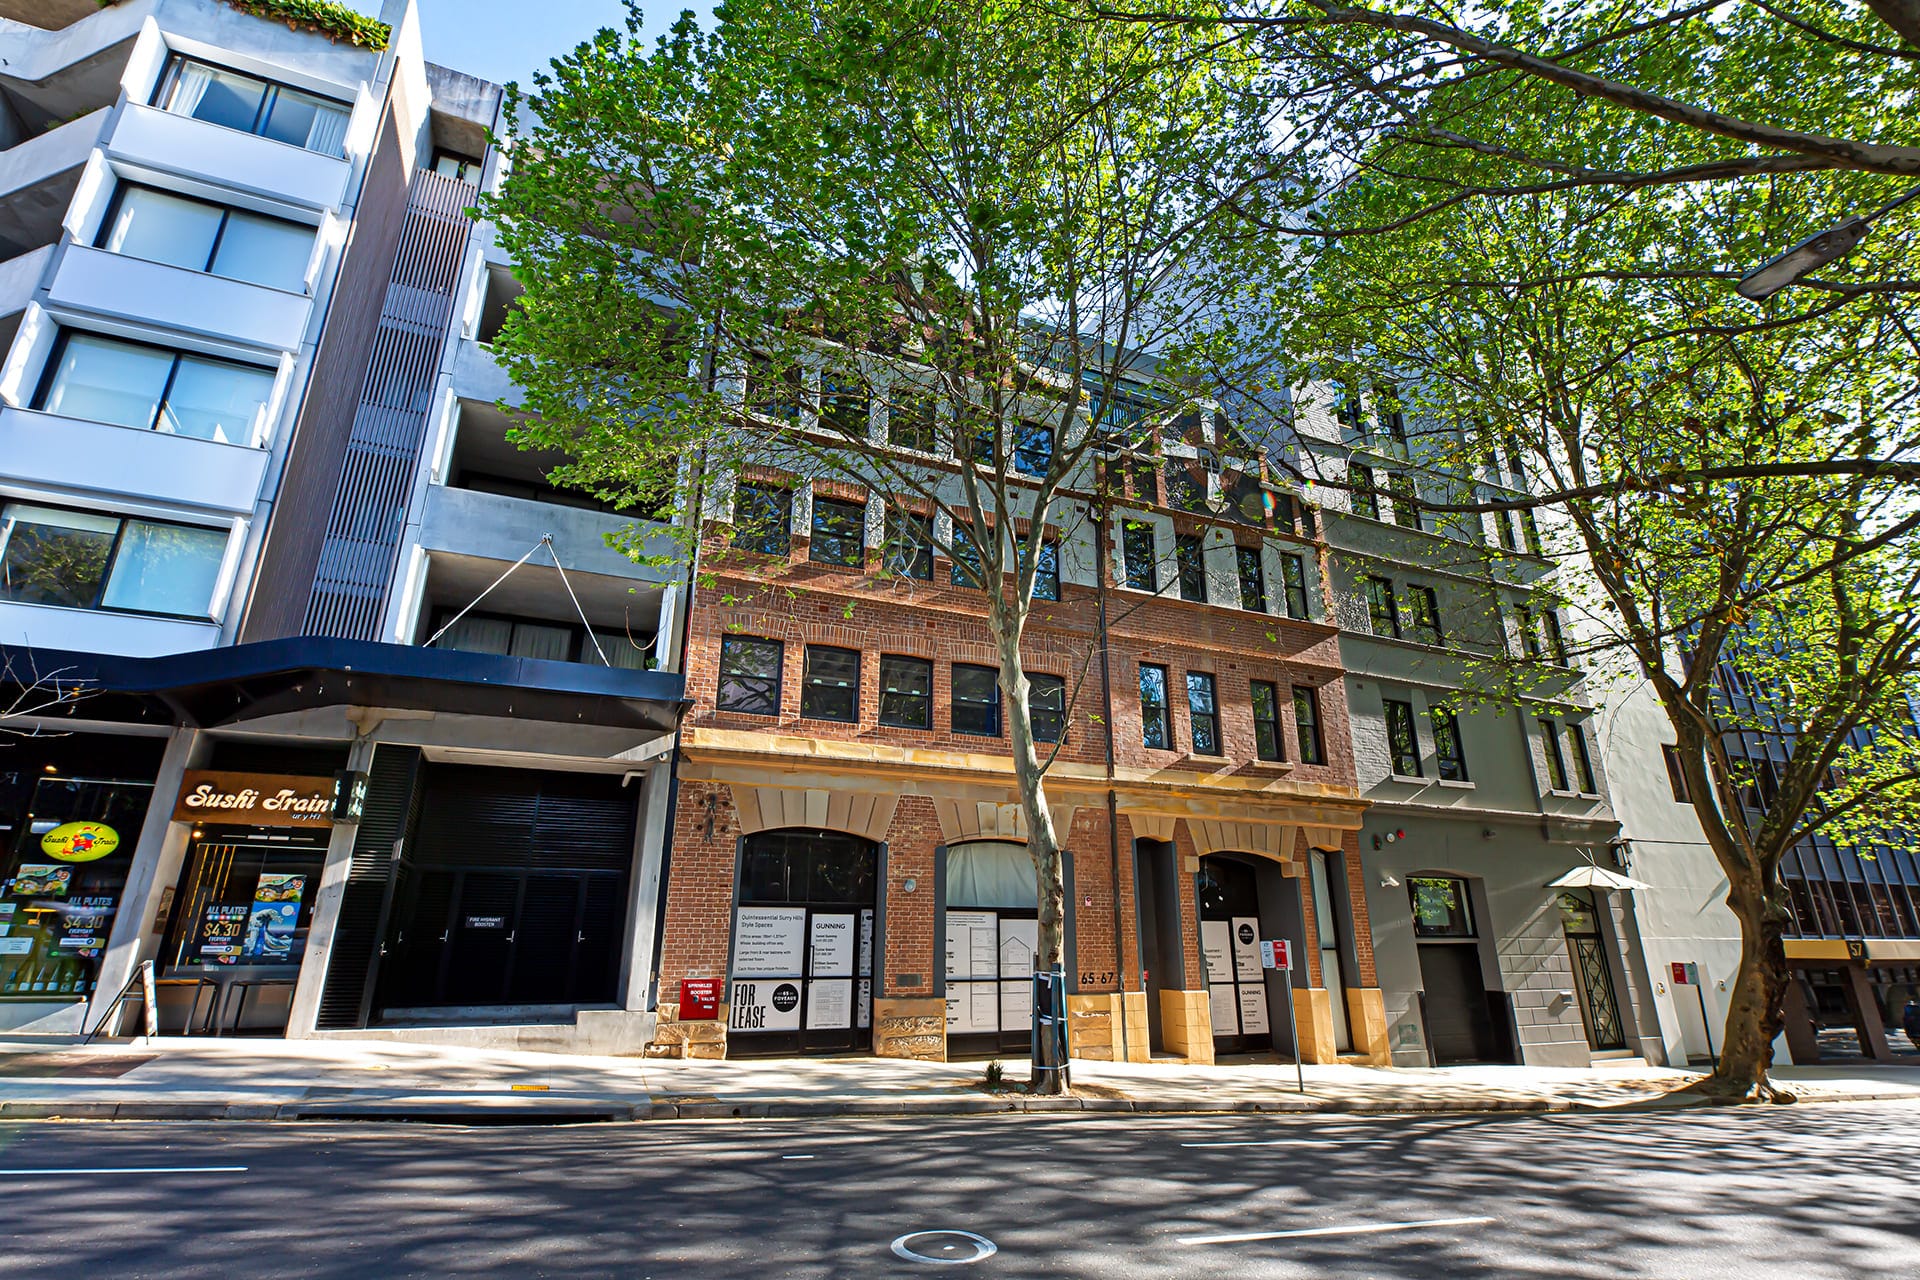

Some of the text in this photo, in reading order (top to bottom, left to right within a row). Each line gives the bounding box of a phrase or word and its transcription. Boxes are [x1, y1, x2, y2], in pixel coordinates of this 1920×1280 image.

[185, 784, 259, 810] Sushi
[262, 789, 330, 813] Train
[44, 835, 117, 845] Sushi Train
[68, 896, 113, 906] ALL PLATES
[206, 906, 248, 915] ALL PLATES
[63, 915, 104, 928] $4.30
[778, 914, 791, 922] Surry
[203, 923, 241, 937] $4.30
[1850, 943, 1862, 957] 57
[1081, 972, 1114, 985] 65-67
[733, 983, 756, 1006] FOR
[731, 1005, 767, 1029] LEASE
